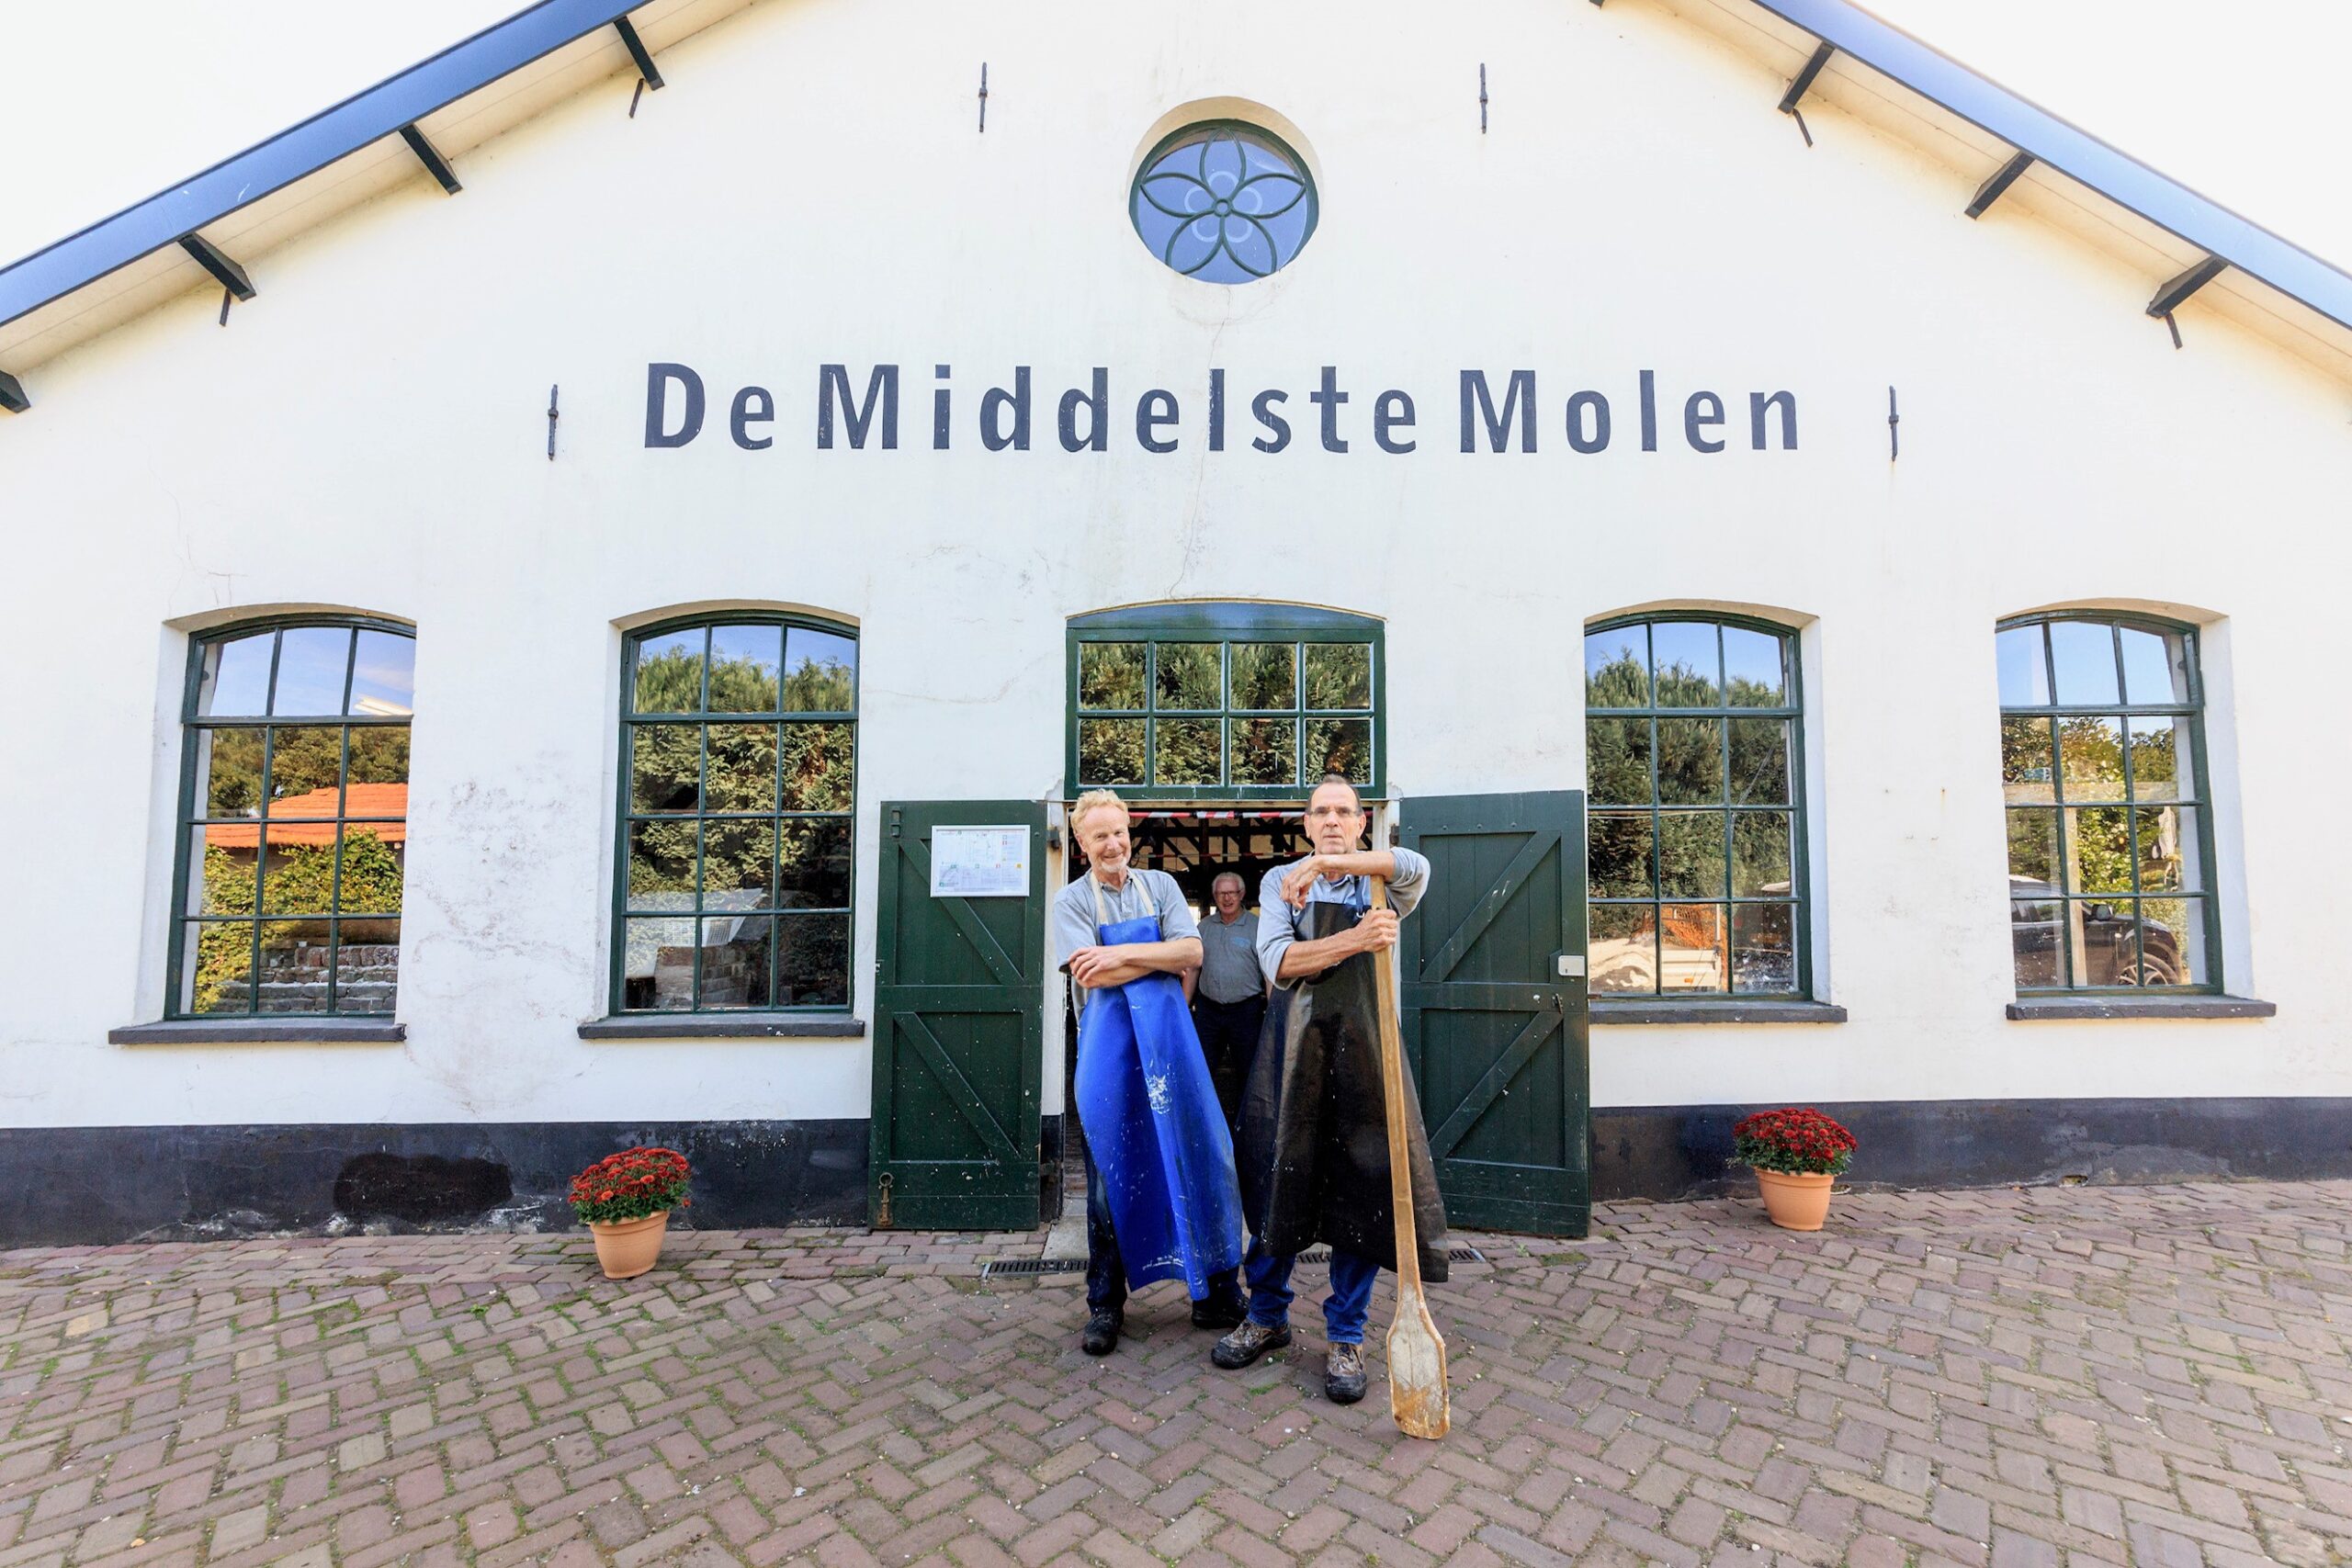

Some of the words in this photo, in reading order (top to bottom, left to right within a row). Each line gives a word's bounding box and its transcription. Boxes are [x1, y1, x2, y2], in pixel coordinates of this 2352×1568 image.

[645, 364, 774, 450] De
[817, 364, 1417, 455] Middelste
[1461, 369, 1798, 455] Molen
